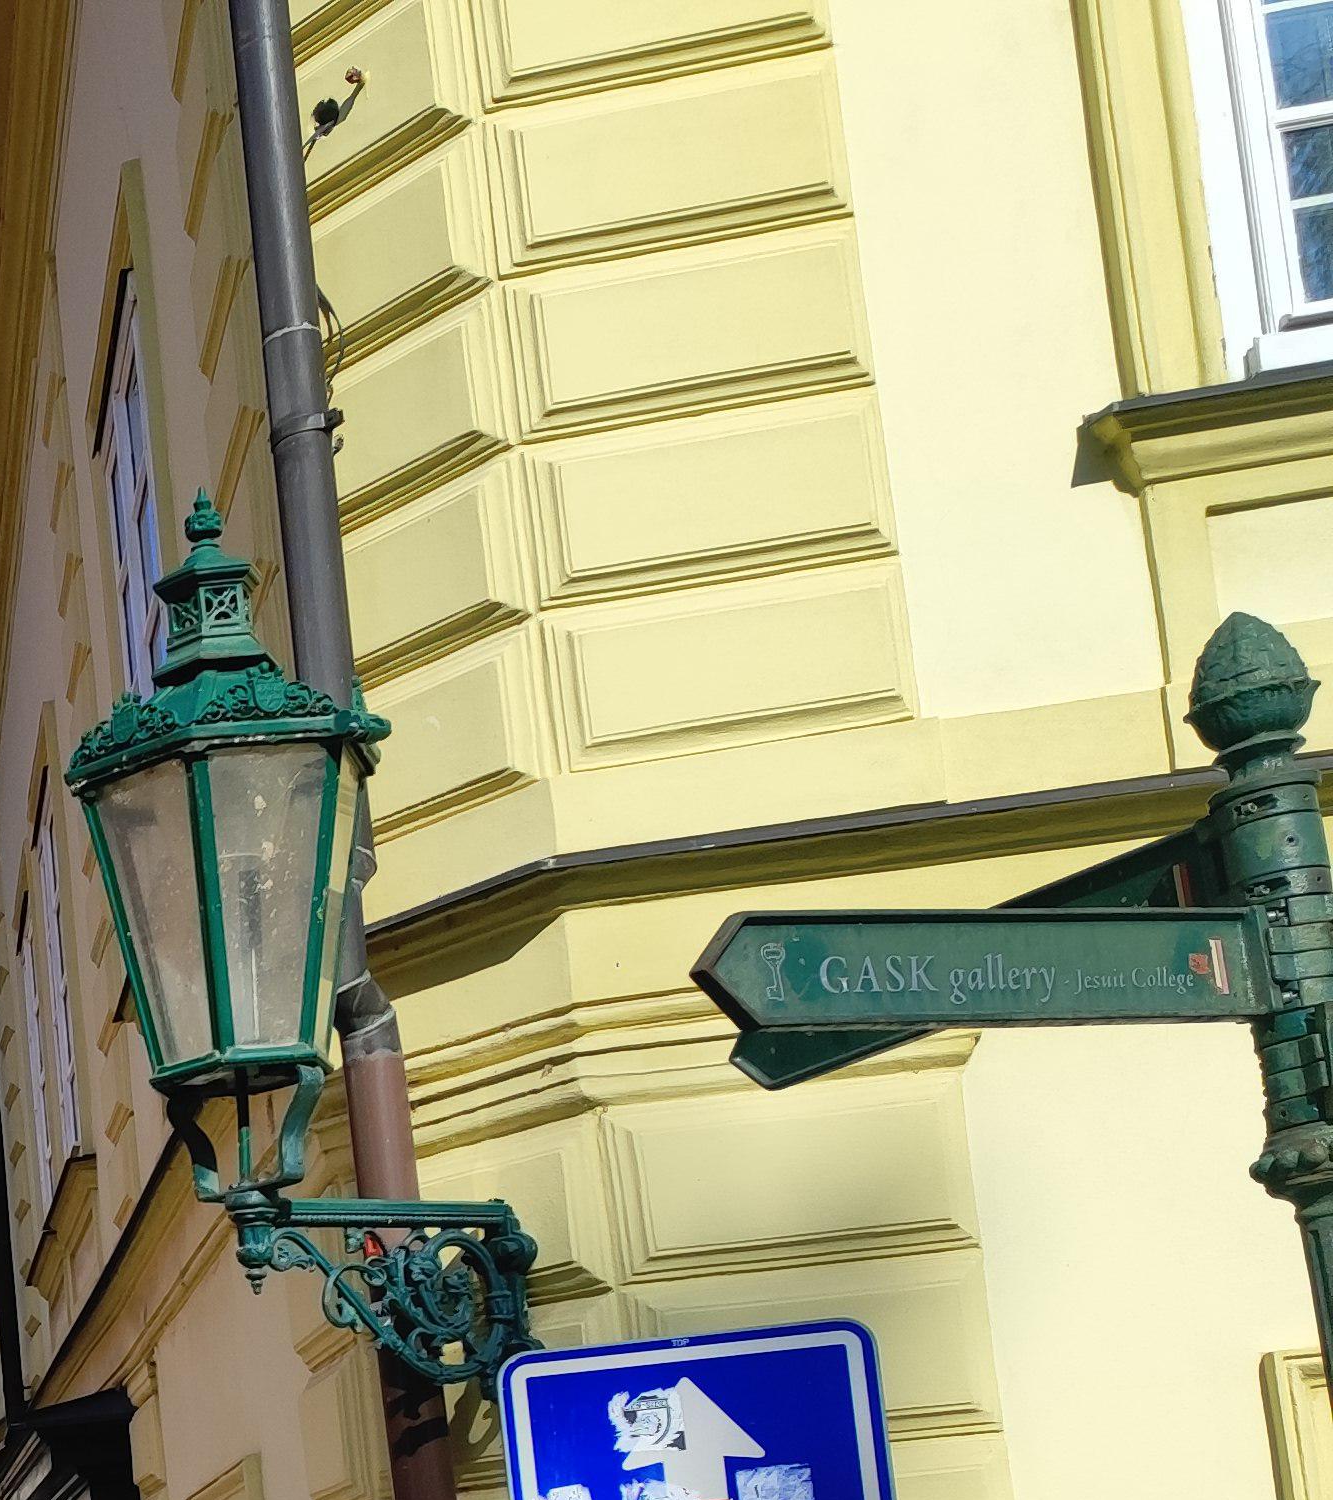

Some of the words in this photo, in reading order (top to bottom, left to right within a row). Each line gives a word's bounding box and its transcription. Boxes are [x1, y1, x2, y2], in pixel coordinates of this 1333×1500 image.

[819, 955, 938, 994] GASK
[949, 953, 1056, 1005] gallery
[1073, 968, 1125, 995] Jesuit
[1132, 966, 1195, 995] College
